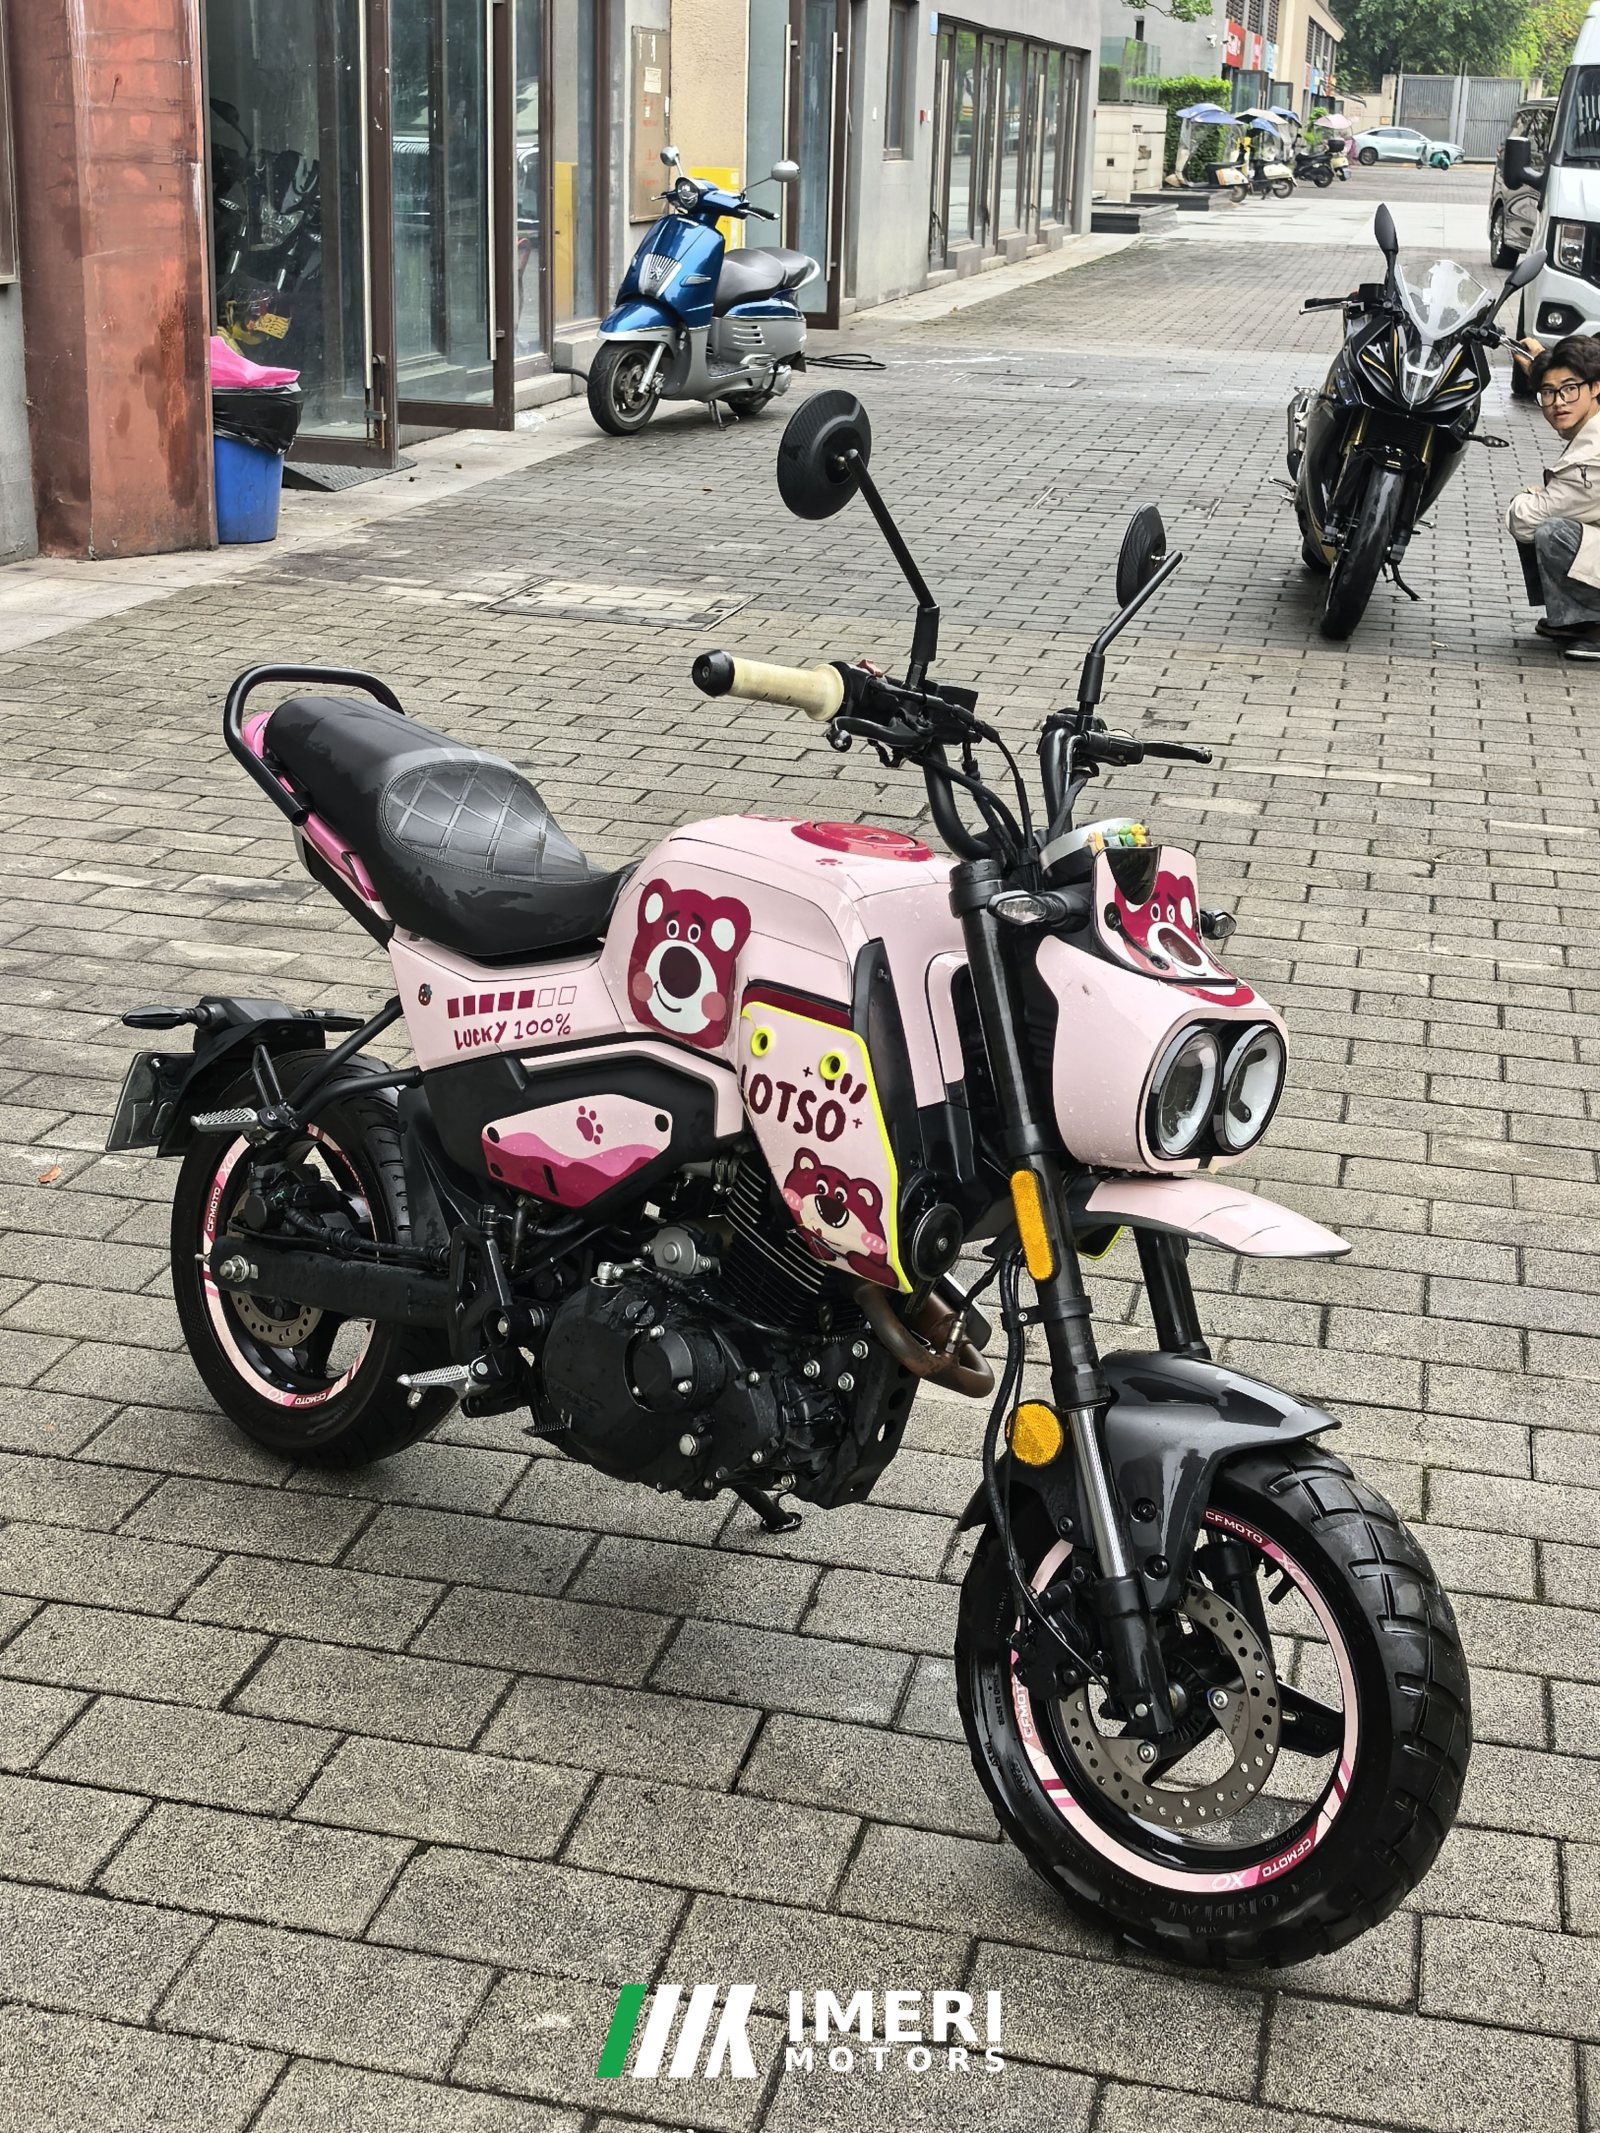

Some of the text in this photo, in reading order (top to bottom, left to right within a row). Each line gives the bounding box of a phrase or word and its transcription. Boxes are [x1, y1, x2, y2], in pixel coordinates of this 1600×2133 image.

[454, 1013, 571, 1050] LUCKY 100%
[207, 1187, 221, 1232] CFMOTO
[295, 1392, 326, 1405] CFMOTO
[1205, 1511, 1263, 1544] CFMOTO
[1262, 1838, 1312, 1878] CFMOTO
[1212, 1871, 1245, 1890] XO
